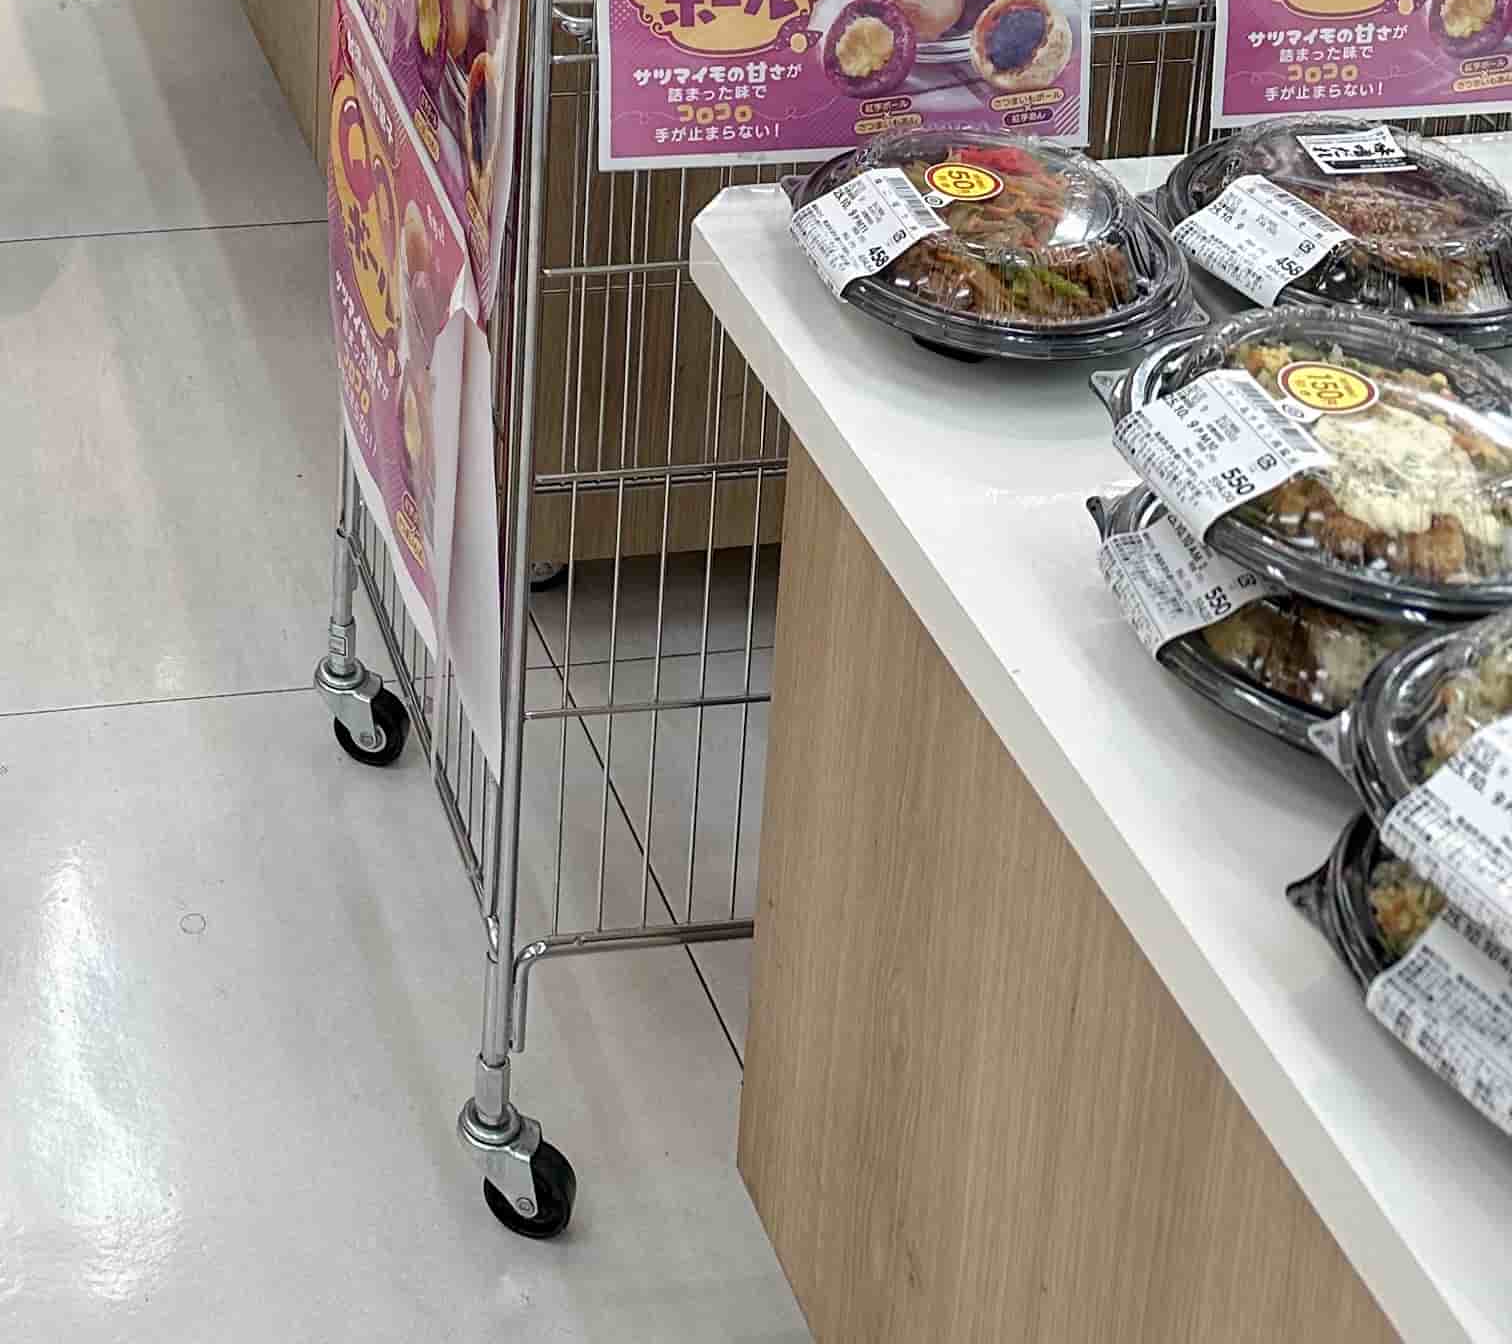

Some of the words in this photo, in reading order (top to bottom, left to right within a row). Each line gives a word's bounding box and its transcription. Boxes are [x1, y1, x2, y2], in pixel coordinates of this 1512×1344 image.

[1247, 22, 1408, 48] サツマイモの甘さが
[1279, 45, 1373, 63] 詰まった味で
[633, 62, 802, 86] サツマイモの甘さが
[1287, 63, 1358, 82] コロコロ
[667, 85, 767, 103] 詰まった味で
[677, 103, 753, 124] コロコロ
[869, 246, 889, 267] 458
[1275, 257, 1305, 276] 458
[1221, 467, 1256, 496] 550
[1205, 586, 1232, 615] 550
